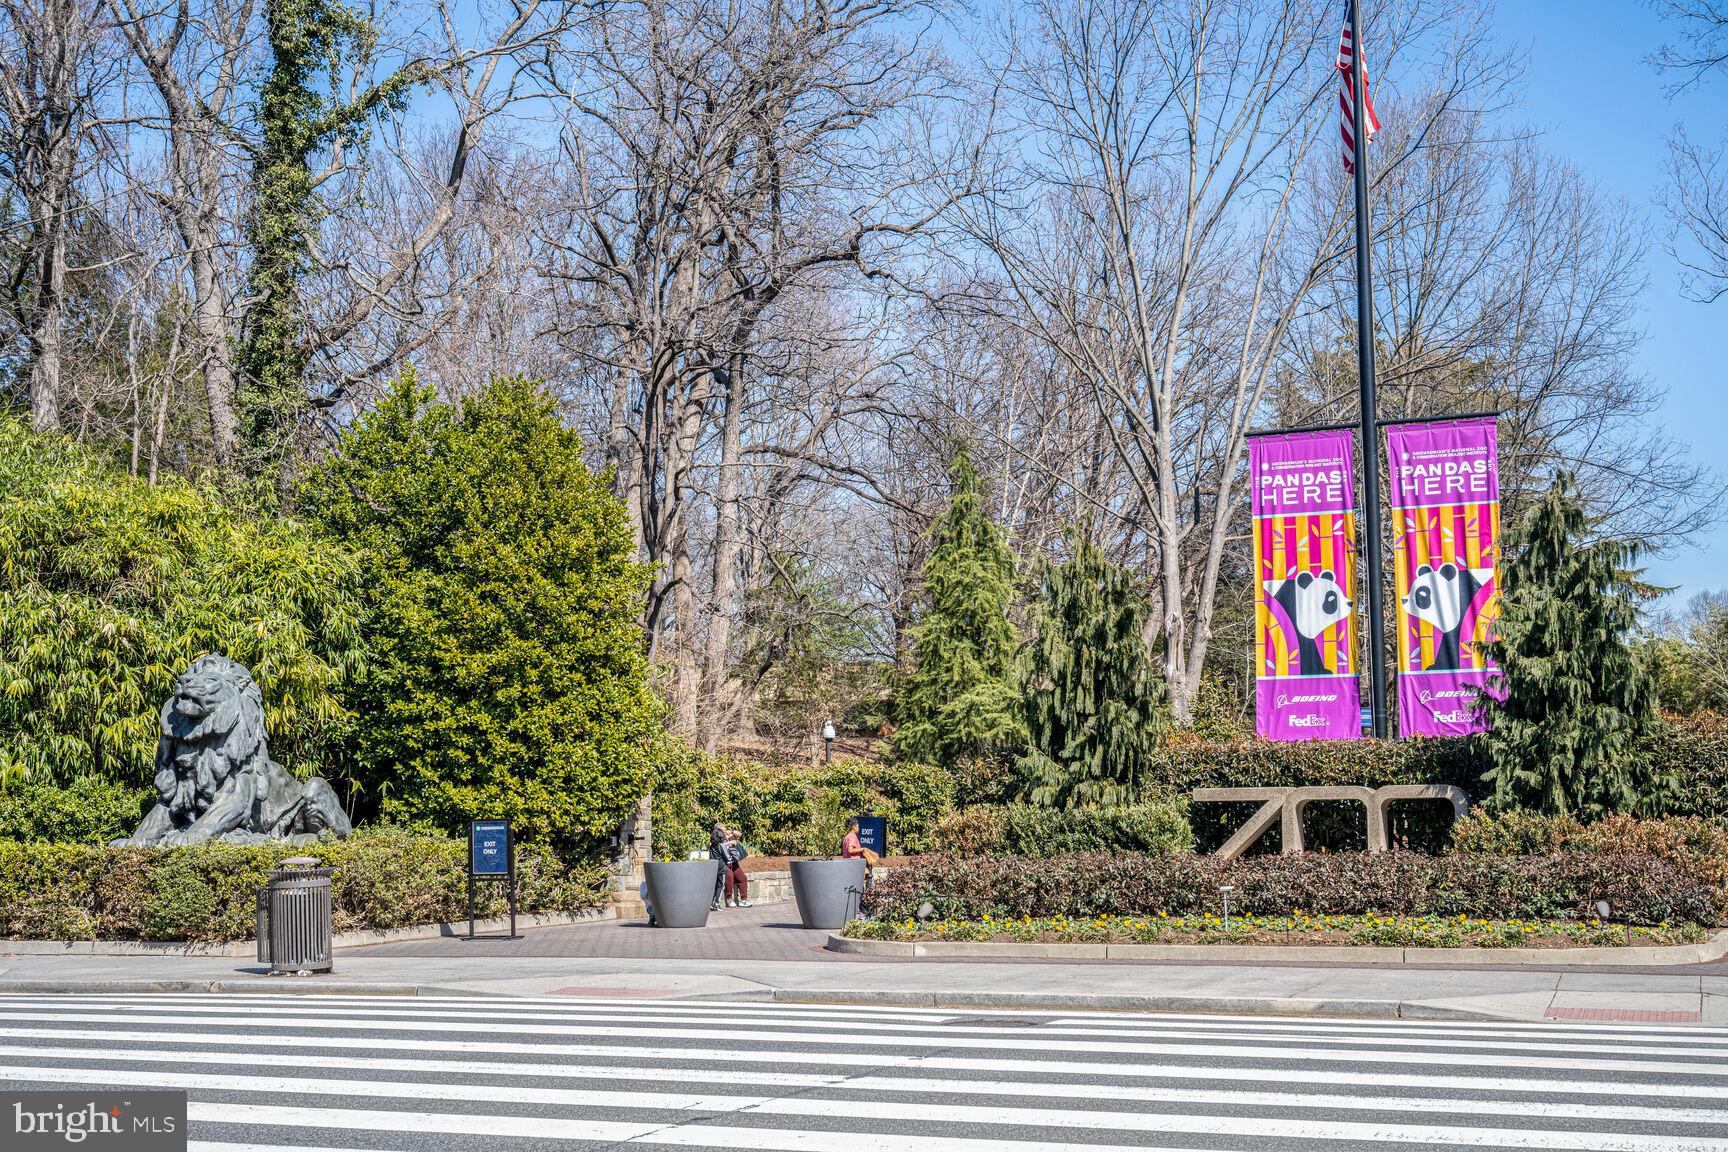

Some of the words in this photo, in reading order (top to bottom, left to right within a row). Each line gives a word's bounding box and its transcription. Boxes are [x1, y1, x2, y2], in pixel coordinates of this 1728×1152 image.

[1401, 459, 1488, 479] PANDAS
[1261, 470, 1342, 488] PANDAS
[1401, 473, 1488, 497] HERE
[1261, 484, 1343, 507] HERE
[1291, 694, 1338, 703] BOEING
[1288, 714, 1326, 727] FedEx
[1433, 710, 1473, 723] FedEx
